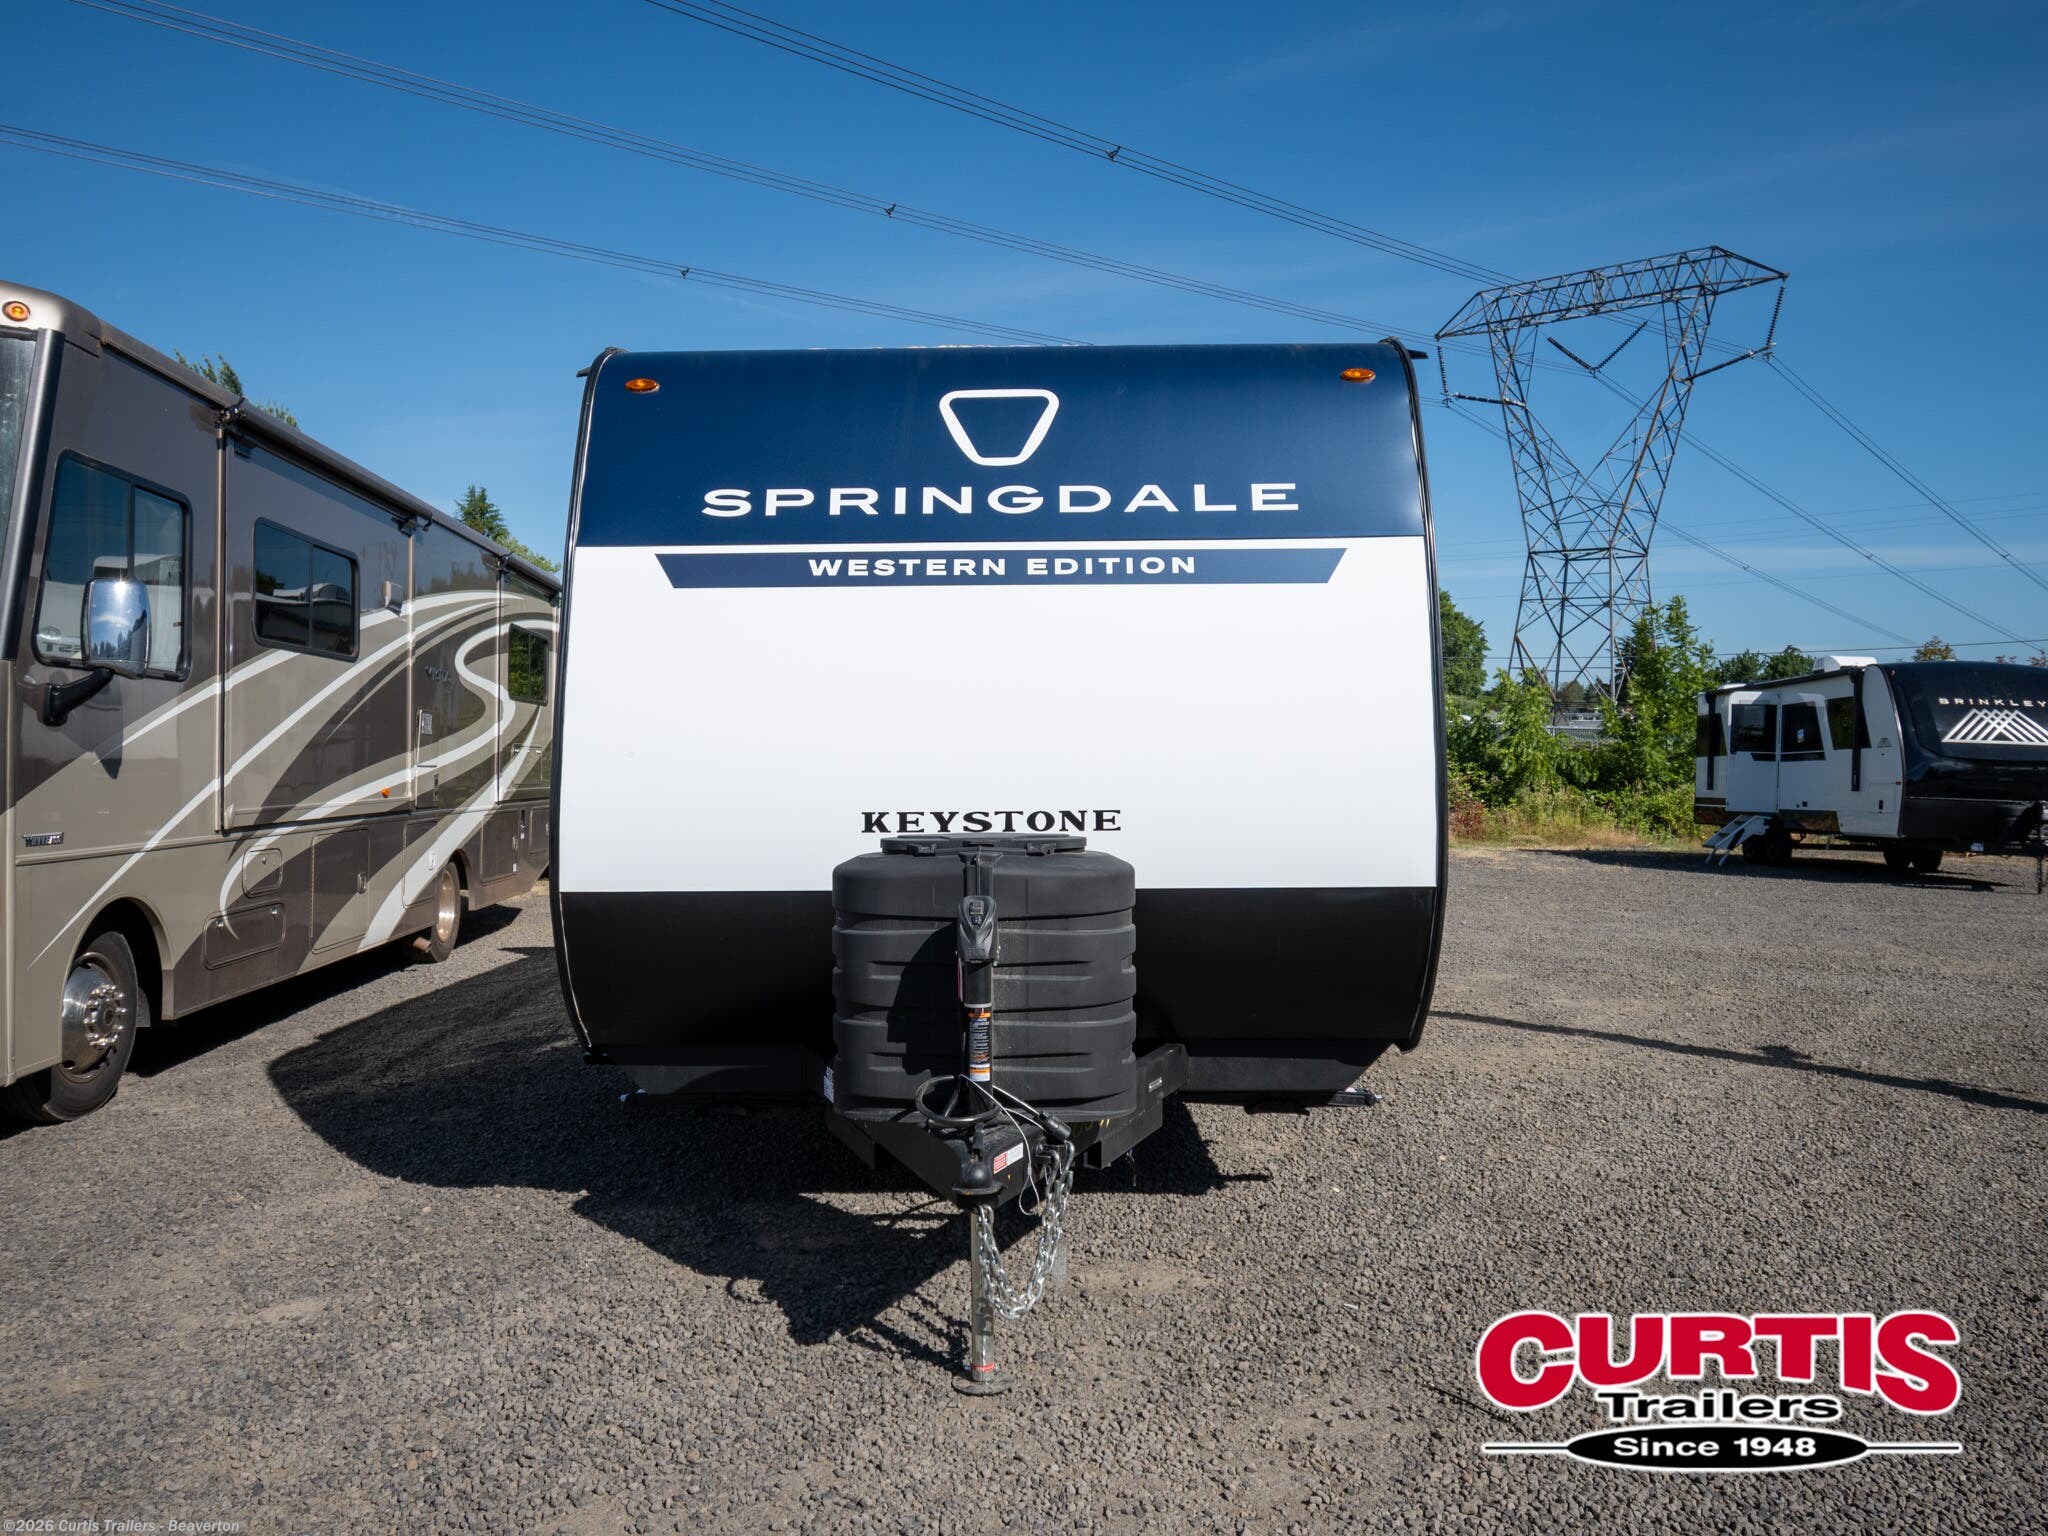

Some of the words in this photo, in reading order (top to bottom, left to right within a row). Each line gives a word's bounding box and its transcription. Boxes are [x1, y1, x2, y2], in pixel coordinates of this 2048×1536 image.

[701, 482, 1300, 518] SPRINGDALE
[808, 558, 1006, 577] WESTERN
[1026, 556, 1196, 576] EDITION
[1938, 697, 2047, 708] BRINKLEY
[861, 810, 1121, 833] KEYSTONE
